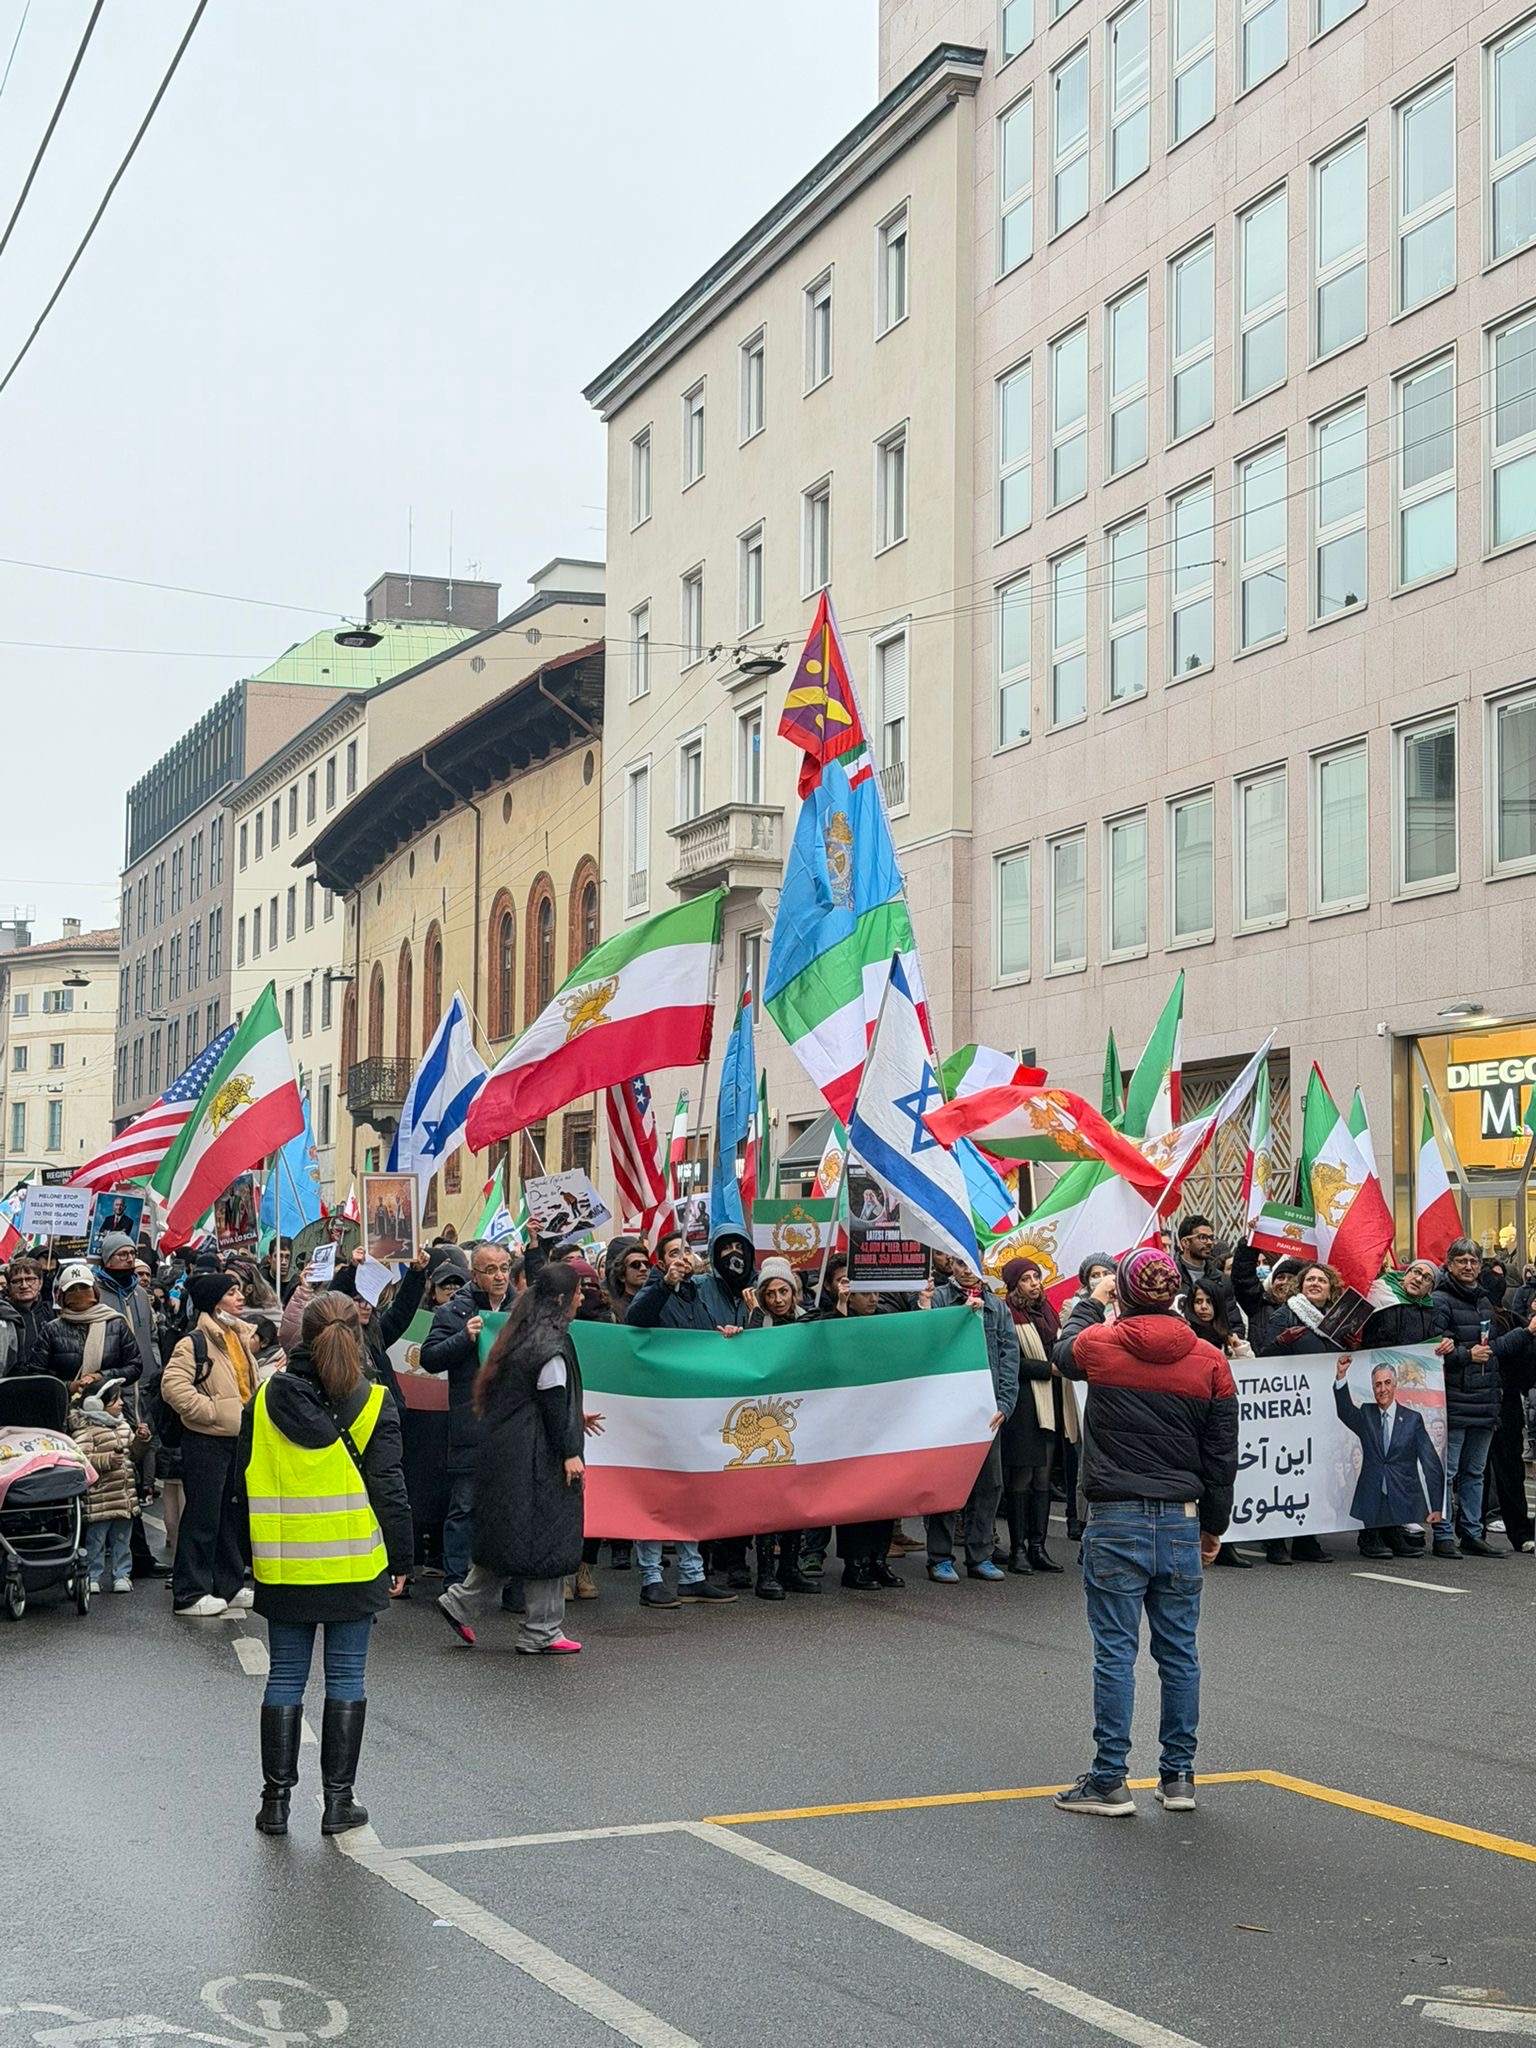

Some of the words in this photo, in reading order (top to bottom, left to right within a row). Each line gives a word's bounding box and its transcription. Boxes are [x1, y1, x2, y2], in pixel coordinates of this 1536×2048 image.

[1295, 1213, 1314, 1222] YEARS
[219, 1238, 234, 1246] VIVA
[235, 1234, 243, 1243] LO
[1276, 1242, 1302, 1252] PAHLAVI
[1237, 1374, 1310, 1395] TTAGLIA
[1240, 1392, 1312, 1421] RNERÀ!
[1237, 1437, 1270, 1471] آخ
[1275, 1437, 1312, 1476] این
[1232, 1485, 1310, 1526] پهلوی
